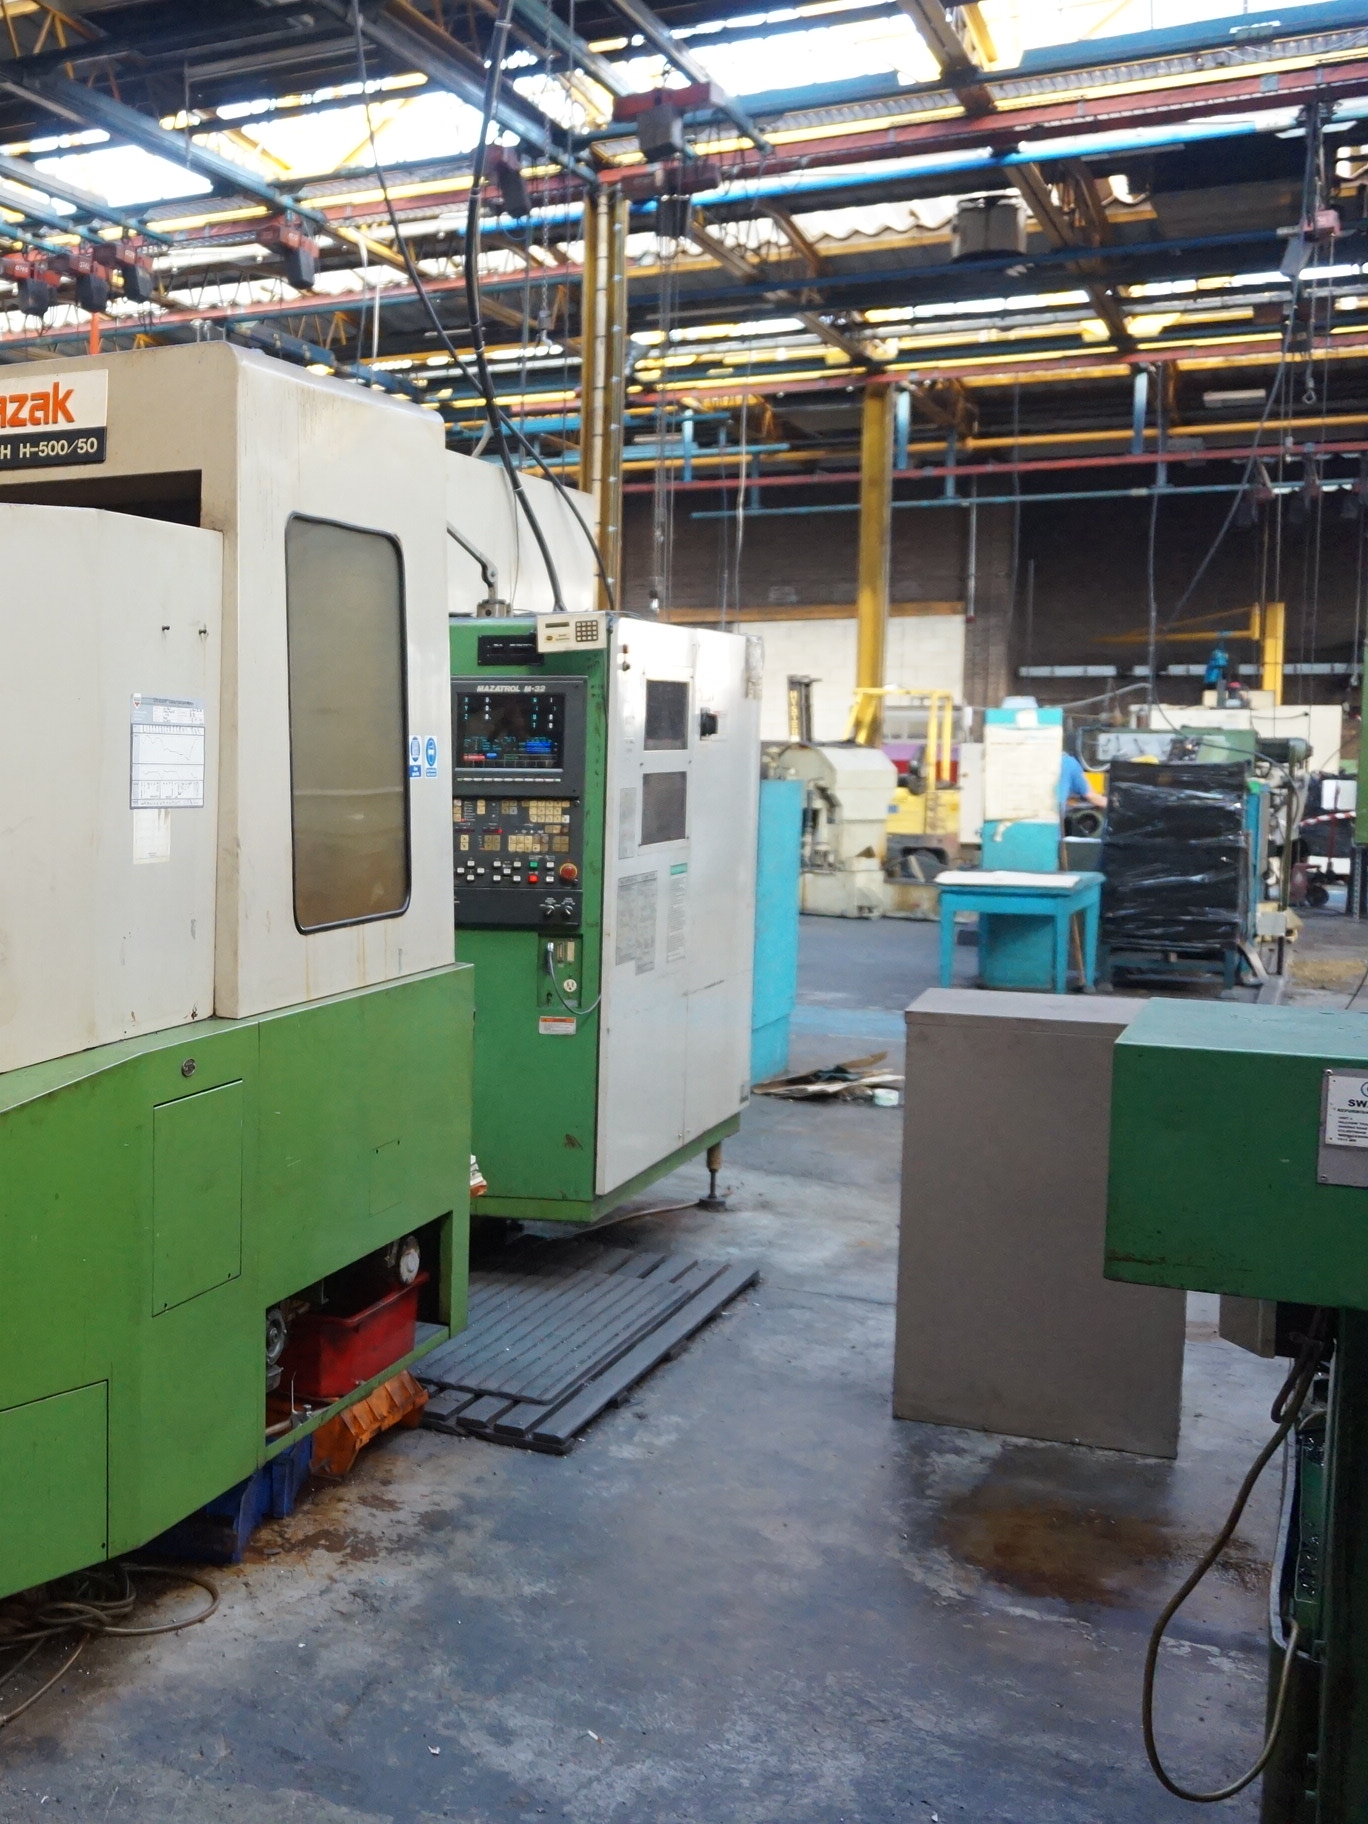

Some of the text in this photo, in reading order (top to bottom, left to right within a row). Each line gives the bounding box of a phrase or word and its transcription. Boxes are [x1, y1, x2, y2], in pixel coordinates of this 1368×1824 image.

[19, 437, 99, 459] H-500/50
[476, 685, 546, 693] MAZATROL M-32
[1348, 1099, 1368, 1108] SW
